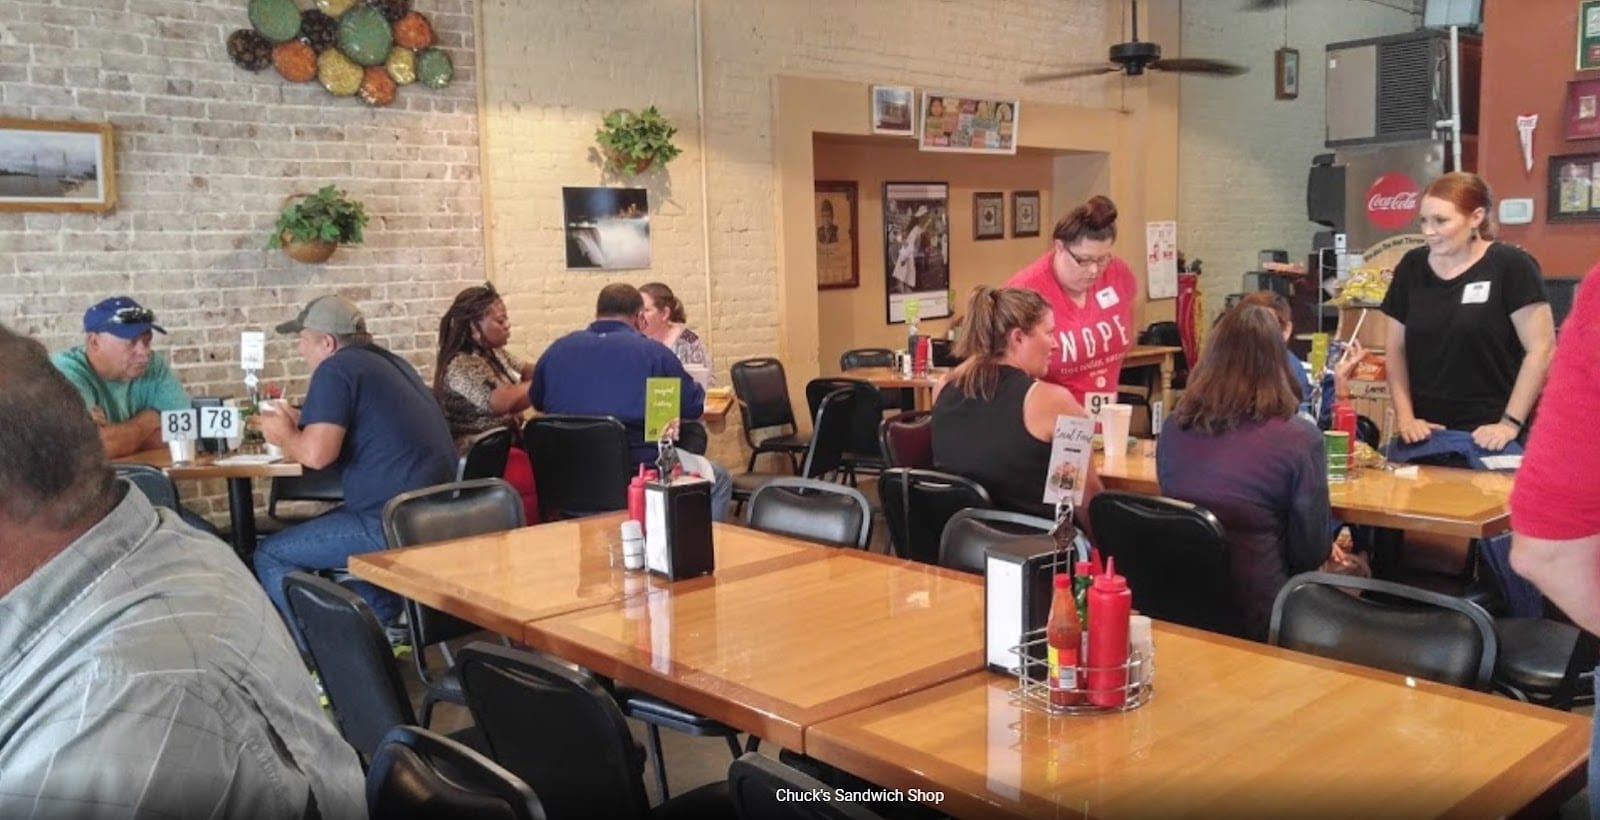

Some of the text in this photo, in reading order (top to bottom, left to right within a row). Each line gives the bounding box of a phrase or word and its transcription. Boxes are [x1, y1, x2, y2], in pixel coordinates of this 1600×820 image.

[1060, 315, 1129, 362] NOPE
[168, 412, 192, 433] 83
[207, 410, 232, 429] 78
